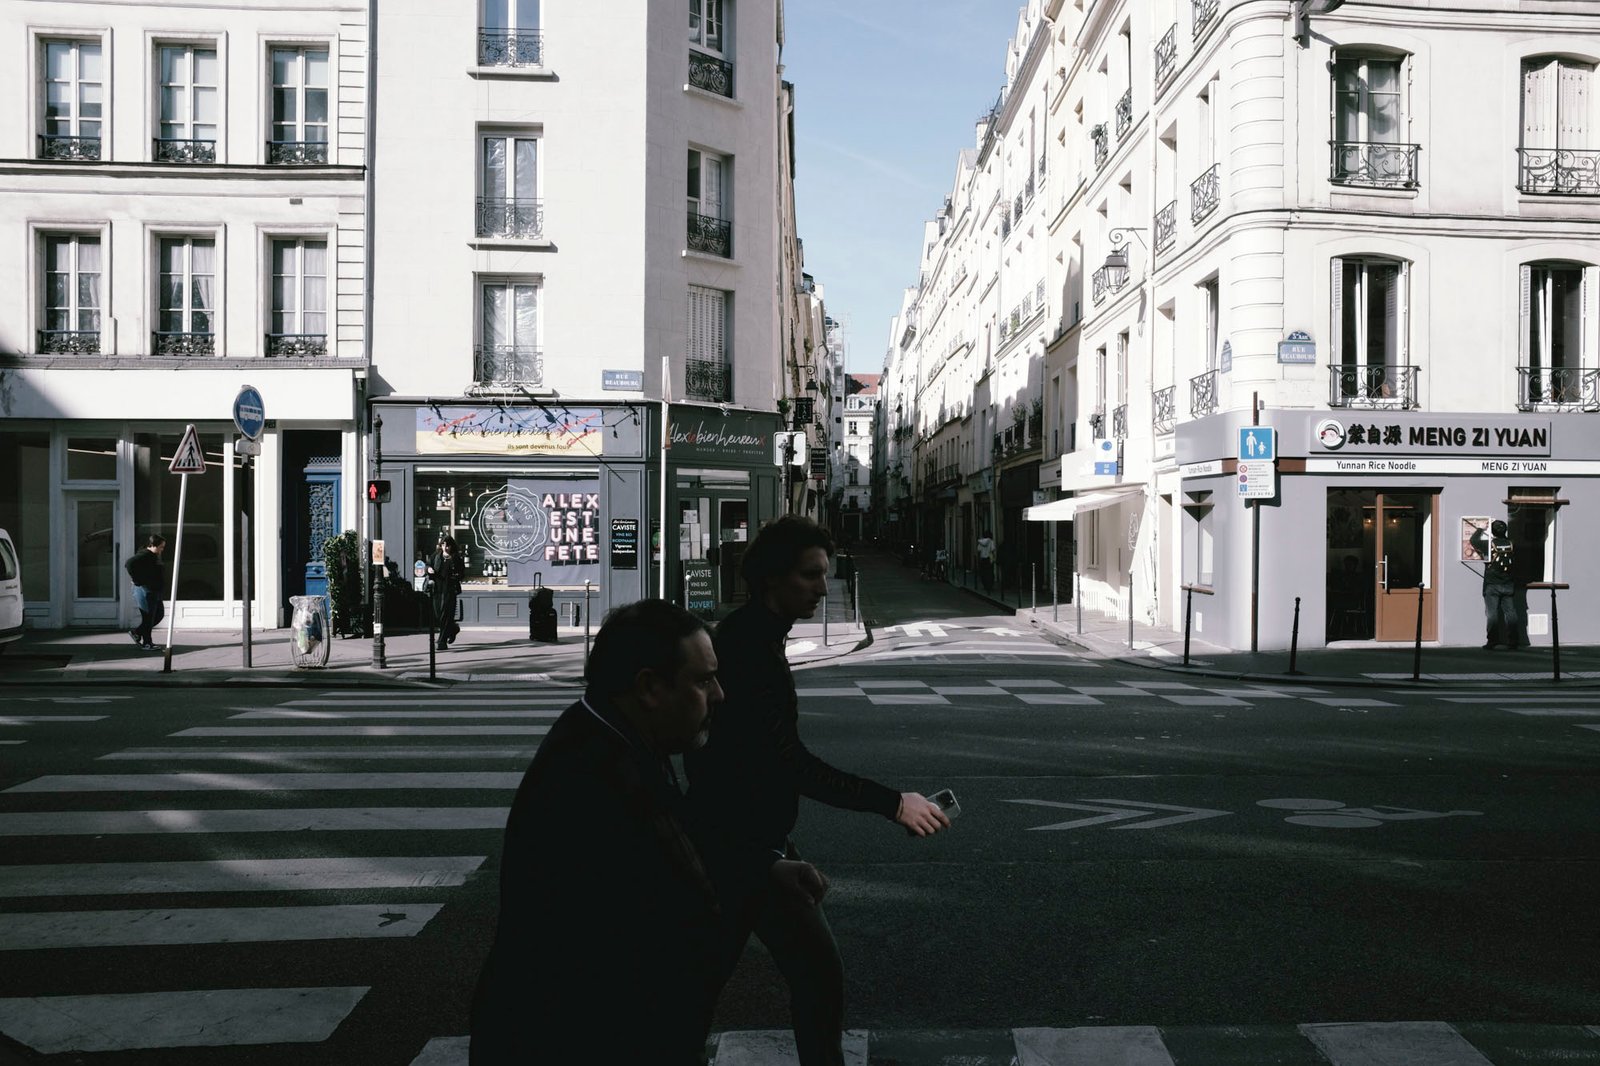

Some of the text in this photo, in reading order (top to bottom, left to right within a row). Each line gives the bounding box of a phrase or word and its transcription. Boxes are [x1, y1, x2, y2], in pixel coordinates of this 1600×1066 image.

[1409, 427, 1547, 447] MENG ZI YUAN
[1336, 461, 1416, 470] Yunnan Rice Noodle
[1481, 462, 1547, 471] MENG ZI YUAN
[542, 494, 599, 509] ALEX
[514, 500, 533, 520] VINS
[550, 511, 593, 526] EST
[491, 533, 529, 547] CAVISTE
[550, 527, 595, 543] UNE
[544, 545, 598, 560] FETE
[685, 569, 712, 578] CAVISTE
